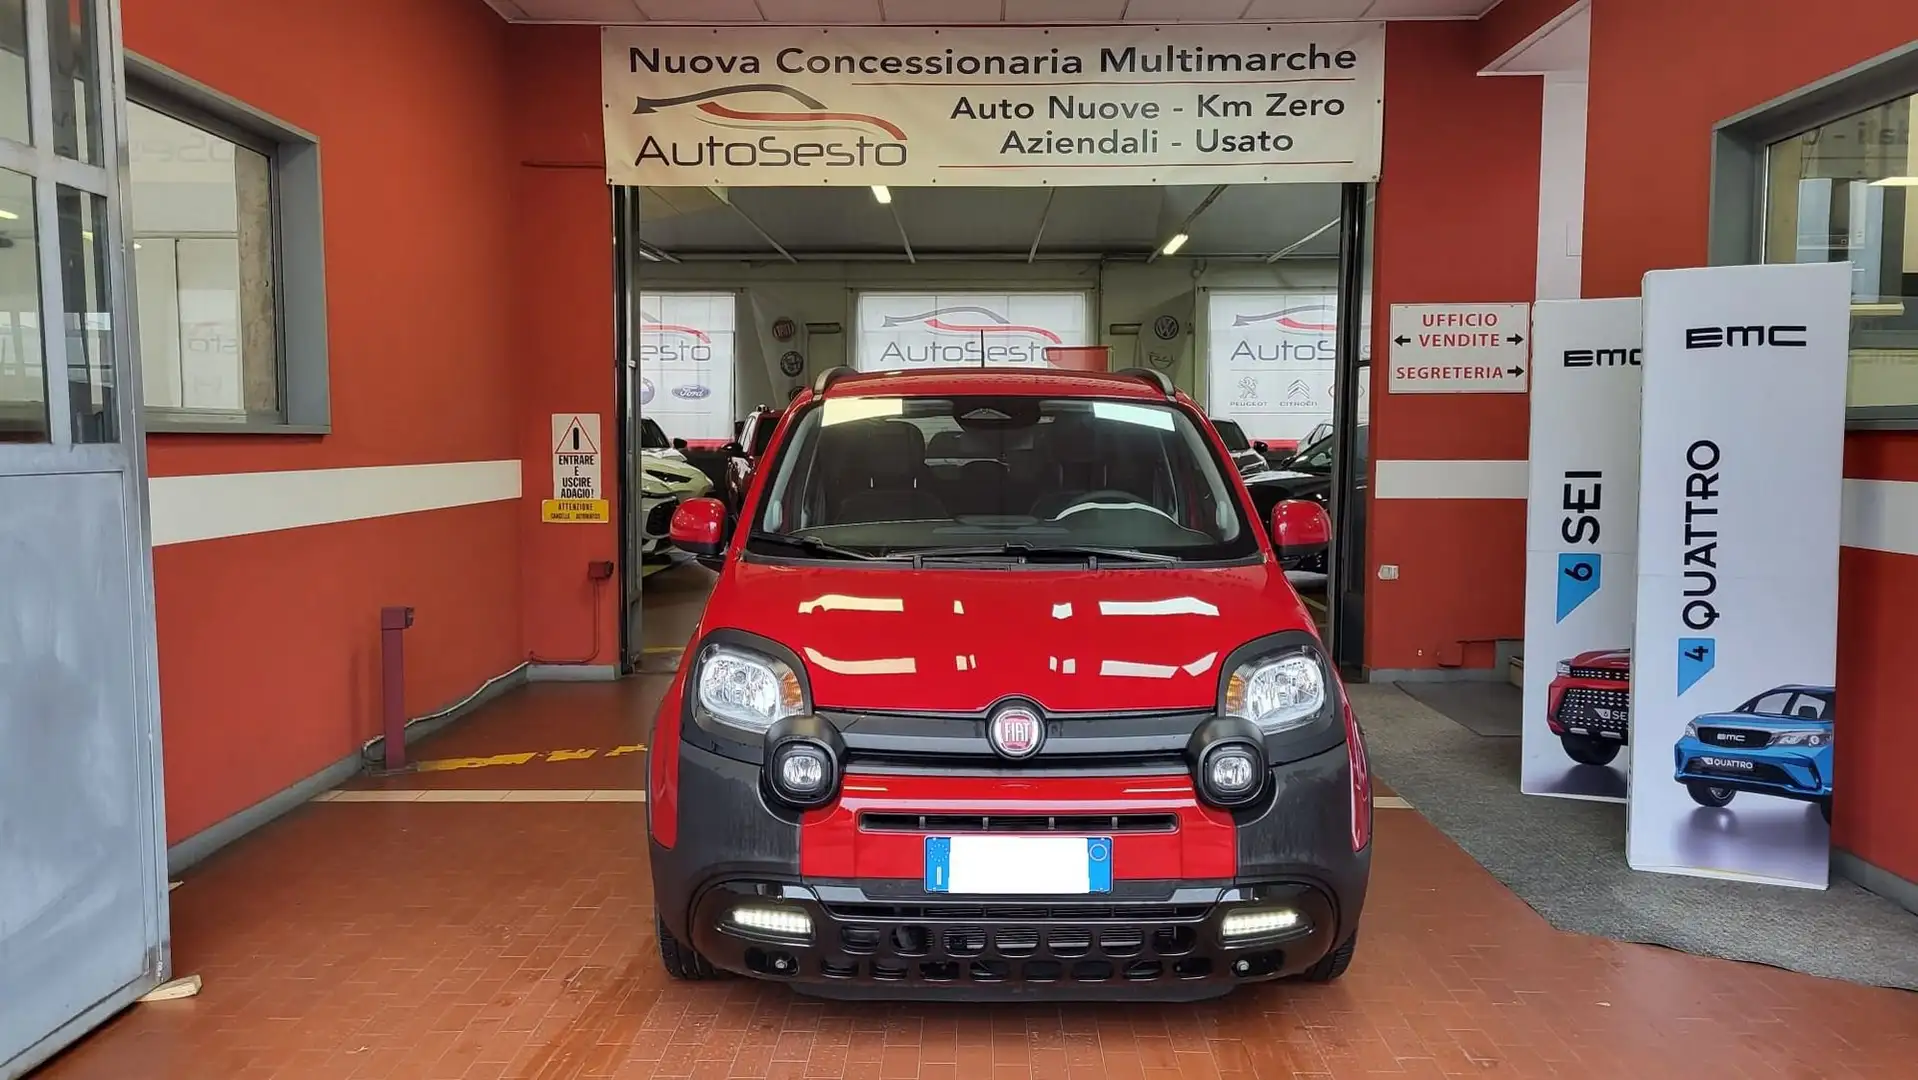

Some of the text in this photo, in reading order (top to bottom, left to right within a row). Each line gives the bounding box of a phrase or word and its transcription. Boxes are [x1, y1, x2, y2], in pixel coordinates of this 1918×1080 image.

[630, 43, 1357, 75] Nuova Concessionaria Multimarche
[950, 96, 1034, 120] Auto
[1049, 95, 1160, 119] Nuove
[1198, 94, 1252, 118] Km
[1266, 92, 1346, 117] Zero
[1000, 129, 1158, 154] Aziendali
[1196, 128, 1294, 153] Usato
[635, 135, 908, 167] AutoSesto
[1422, 313, 1498, 327] UFFICIO
[1418, 333, 1500, 347] VENDITE
[880, 340, 1063, 362] AutoSesto
[1396, 366, 1503, 380] SEGRETERIA
[558, 455, 595, 465] ENTRARE
[574, 466, 579, 476] E
[562, 477, 591, 487] USCIRE
[561, 488, 594, 499] ADAGIO!
[558, 503, 593, 511] ATTENZIONE
[1562, 471, 1602, 582] 6 SEI
[1682, 440, 1720, 662] 4 QUATTRO
[1004, 722, 1031, 742] FIAT
[1714, 757, 1753, 769] QUATTRO
